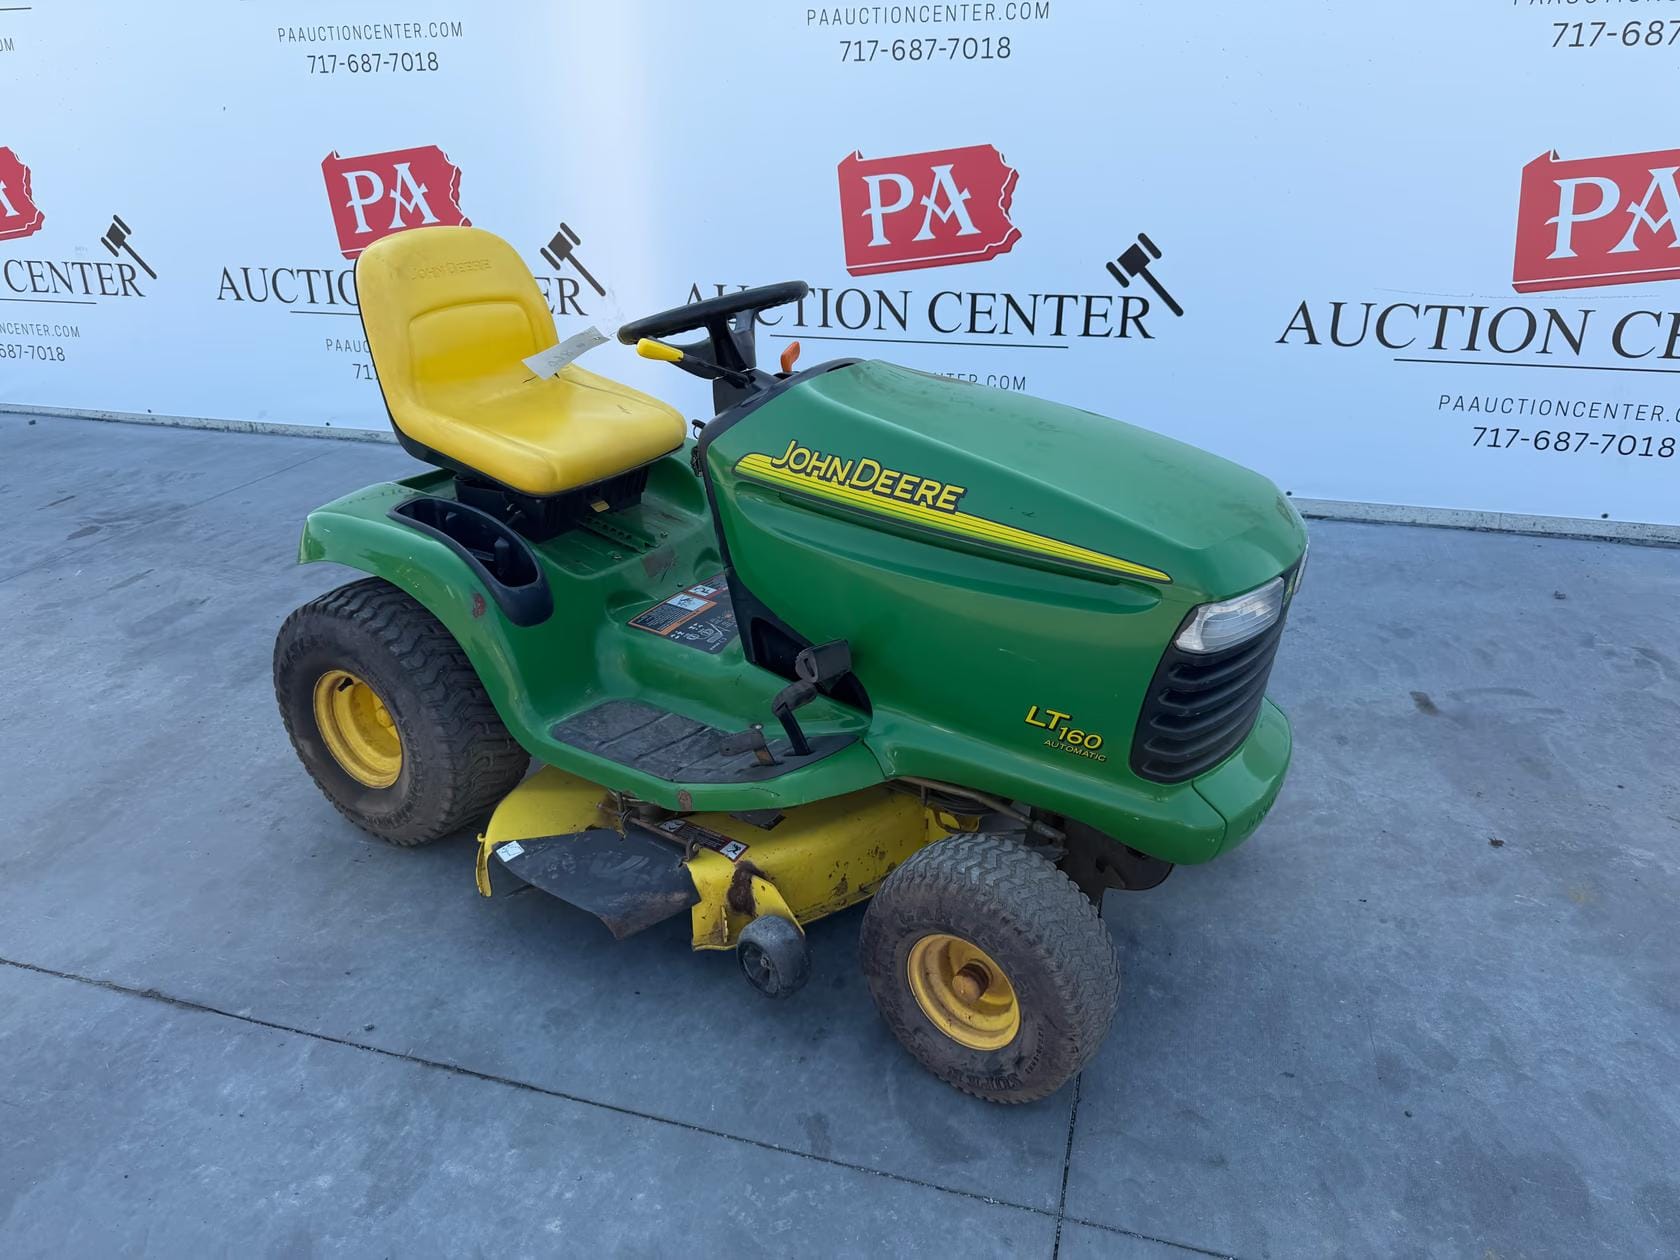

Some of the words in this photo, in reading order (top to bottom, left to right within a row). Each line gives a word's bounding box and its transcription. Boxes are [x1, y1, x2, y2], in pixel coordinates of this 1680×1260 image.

[278, 21, 463, 43] PAAUCTIONCENTER.COM
[807, 1, 1049, 26] PAAUCTIONCENTER.COM
[307, 52, 439, 74] 717-687-7018
[839, 36, 1011, 62] 717-687-7018
[341, 162, 441, 234] PA
[861, 164, 982, 247] PA
[1544, 166, 1680, 260] PA
[3, 259, 147, 297] CENTER
[217, 266, 358, 306] AUCTIO
[927, 290, 1156, 339] CENTER
[1275, 300, 1596, 356] AUCTION
[1472, 426, 1676, 458] 717-687-7018
[771, 439, 854, 486] JOHN
[849, 457, 967, 512] DEERE
[1043, 739, 1107, 762] AUTOMATIC
[1058, 727, 1103, 750] 160
